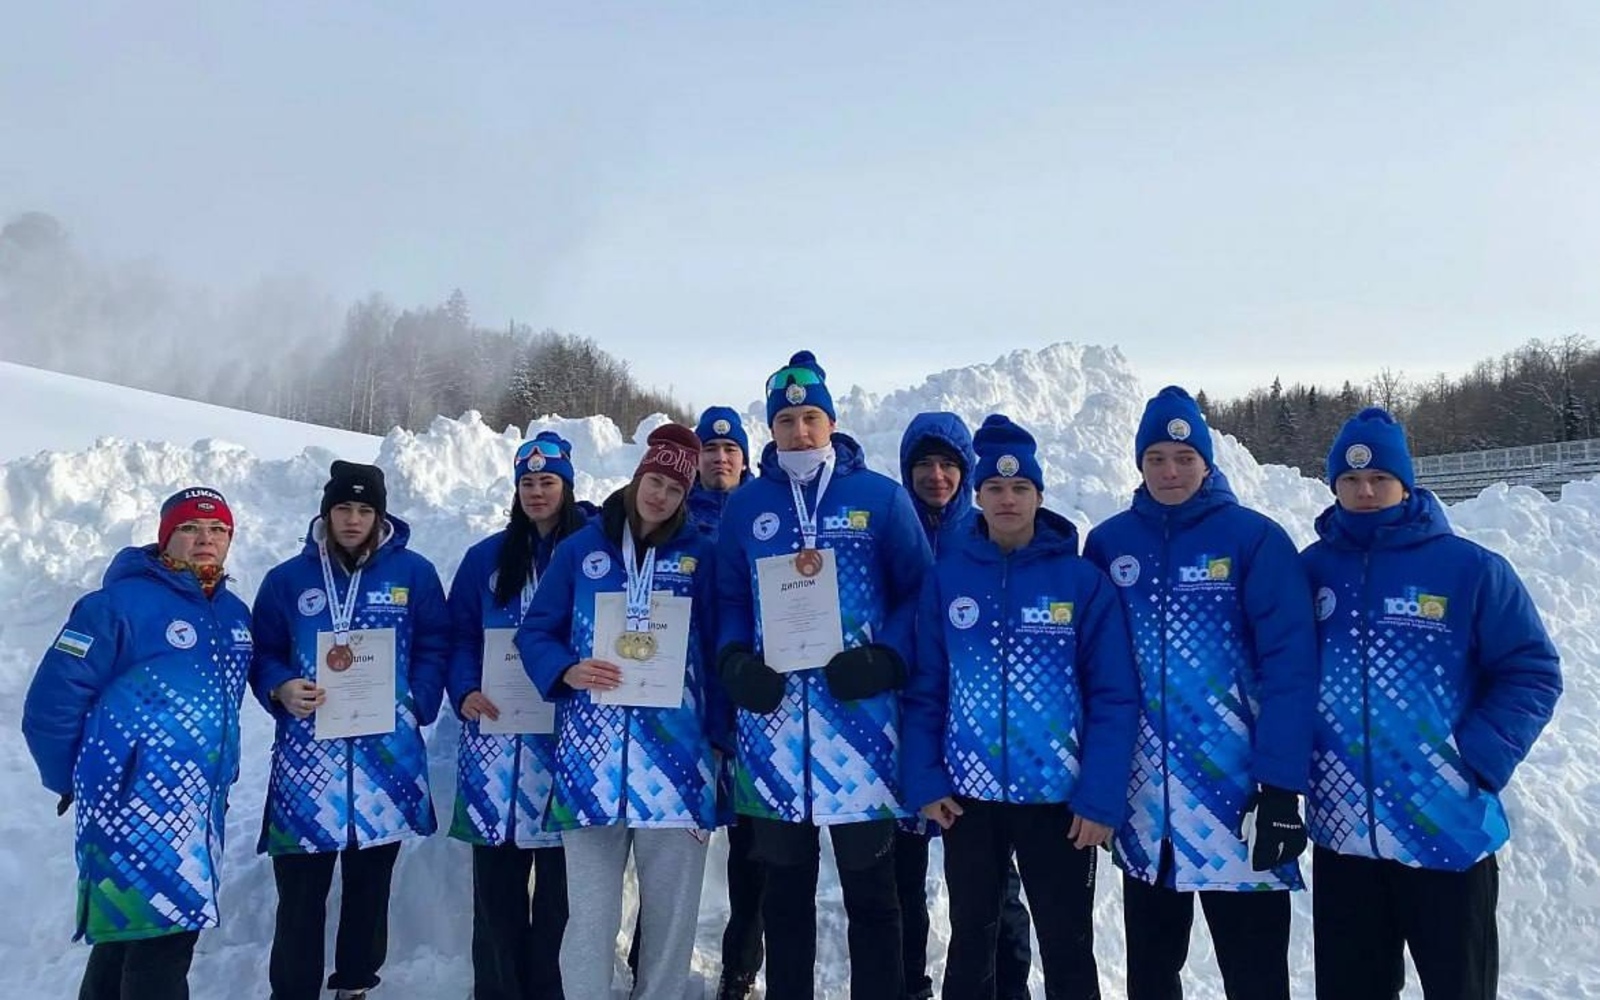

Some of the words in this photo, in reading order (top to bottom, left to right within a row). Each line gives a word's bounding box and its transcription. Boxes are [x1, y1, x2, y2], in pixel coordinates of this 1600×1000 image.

[1179, 566, 1211, 582] 100
[781, 579, 816, 592] ДИПЛОМ
[1384, 597, 1422, 616] 100
[1021, 607, 1053, 623] 100
